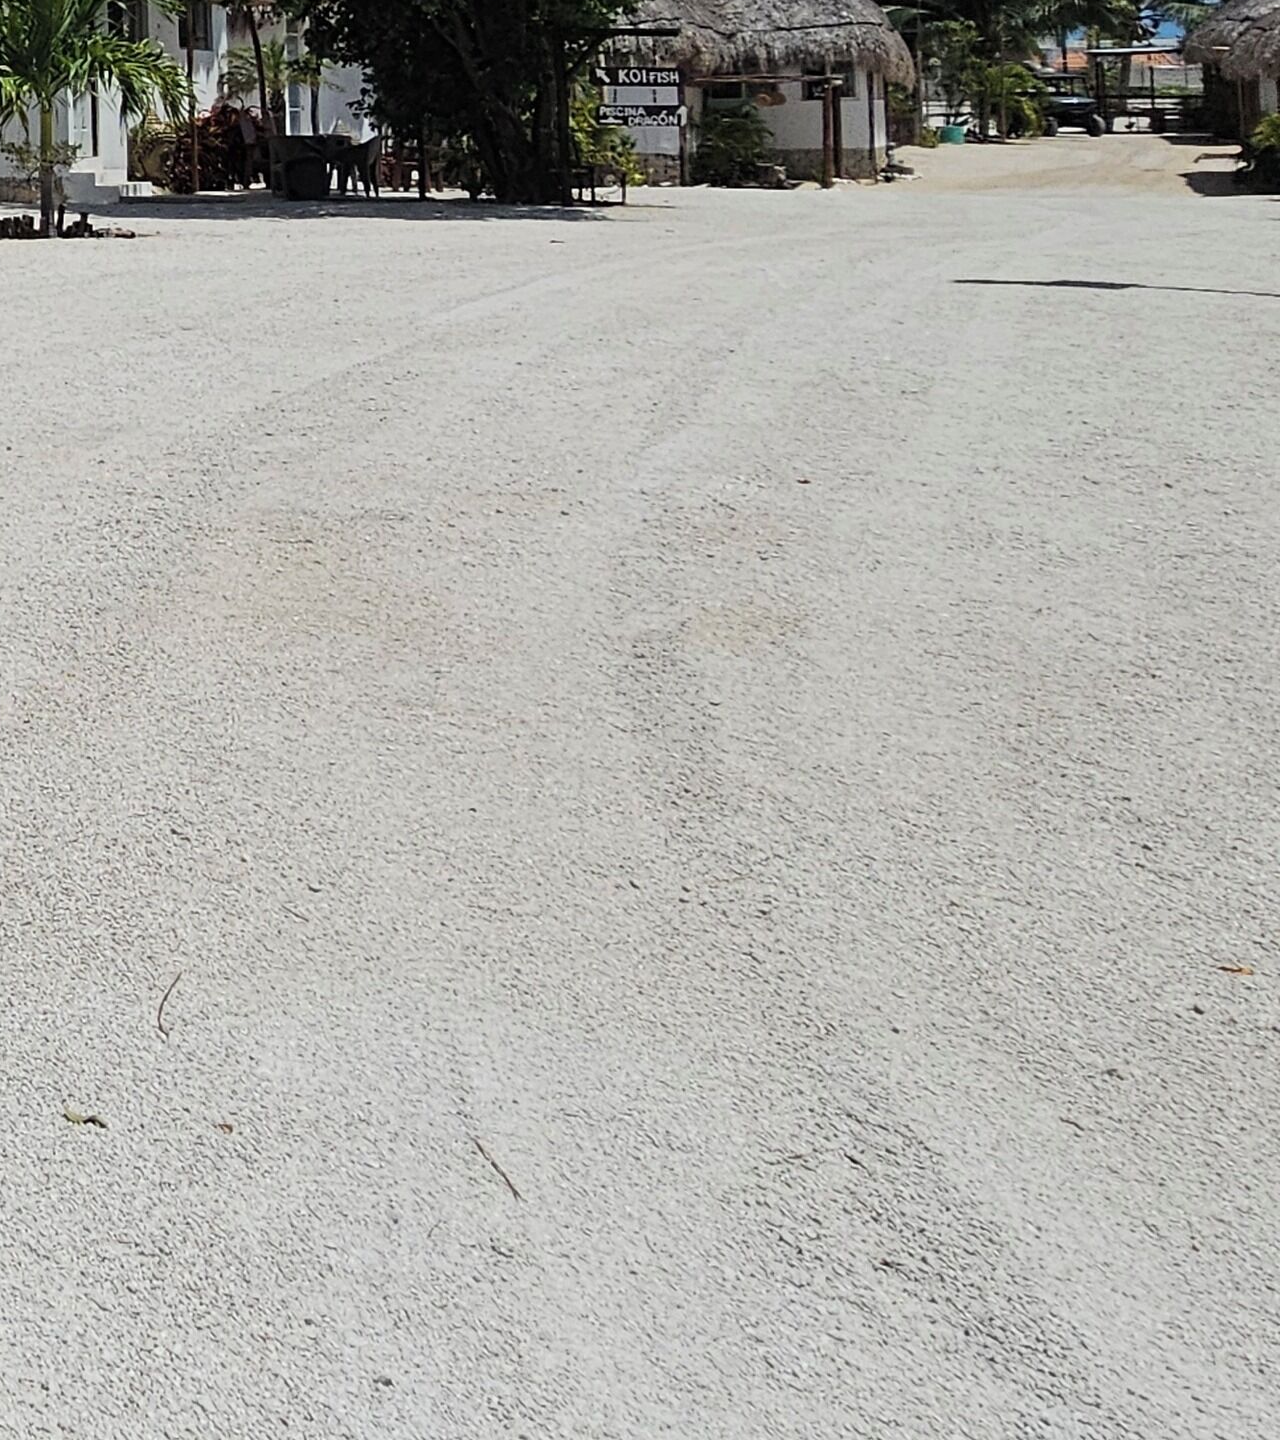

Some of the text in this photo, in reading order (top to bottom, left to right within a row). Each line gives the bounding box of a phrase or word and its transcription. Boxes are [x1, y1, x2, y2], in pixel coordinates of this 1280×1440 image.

[618, 68, 680, 84] KOI FISH
[599, 106, 647, 117] PISCINA
